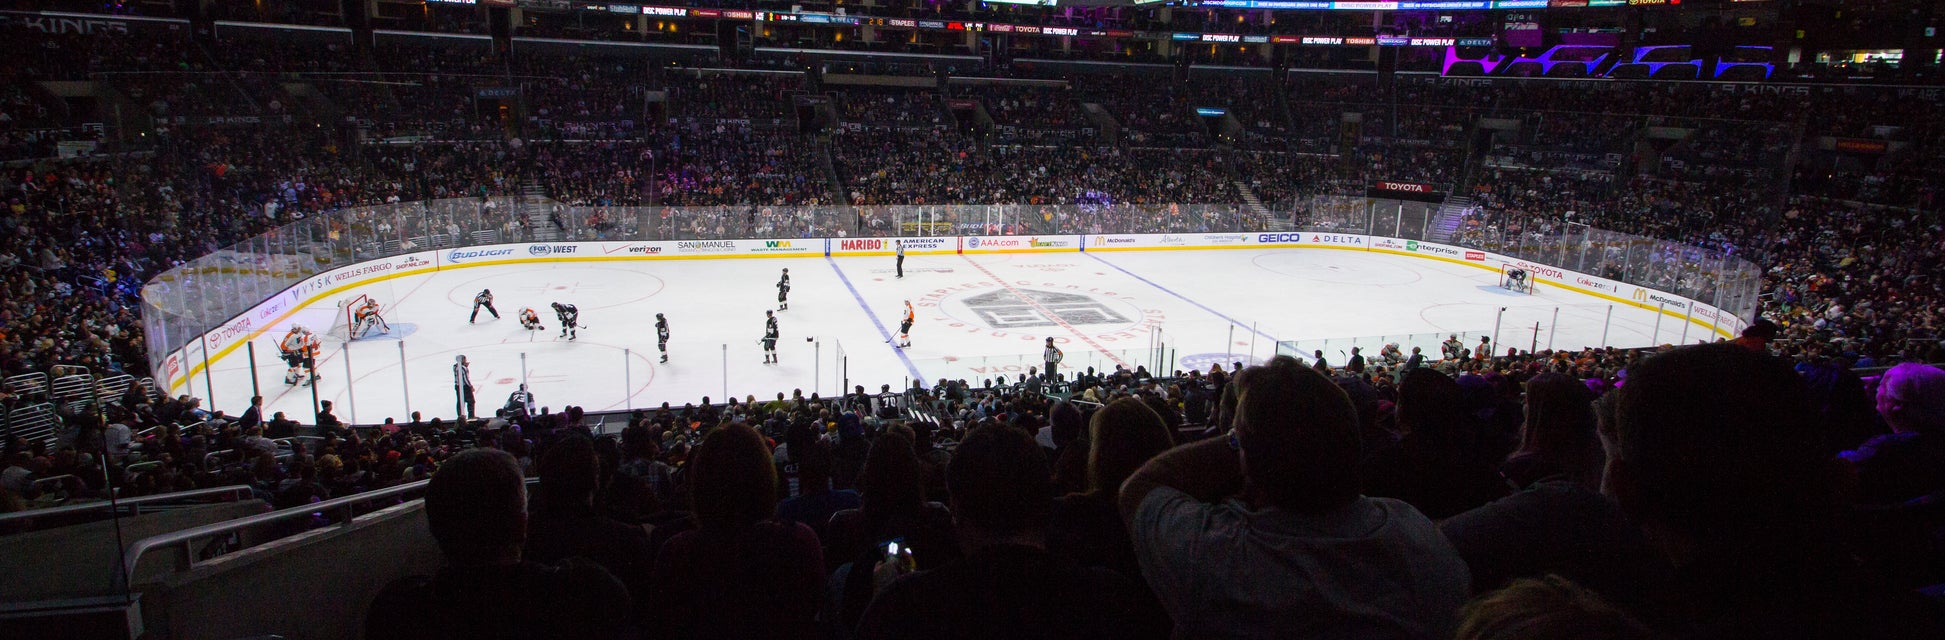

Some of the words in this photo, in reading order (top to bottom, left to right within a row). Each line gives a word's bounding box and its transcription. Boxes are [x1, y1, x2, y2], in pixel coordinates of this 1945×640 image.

[642, 6, 655, 14] DISC
[655, 7, 674, 15] POWER
[674, 8, 687, 16] PLAY
[890, 19, 915, 27] STAPLES
[1014, 25, 1040, 33] TOYOTA
[1385, 182, 1423, 192] TOYOTA
[981, 238, 1019, 247] AAA.com
[1258, 233, 1300, 243] GEICO
[1323, 235, 1362, 244] DELTA
[553, 245, 577, 254] WEST
[628, 245, 662, 254] verizon
[677, 241, 695, 249] SAN
[841, 239, 881, 250] HARIBO
[452, 250, 478, 260] BUD
[479, 249, 514, 257] LIGHT
[334, 268, 362, 281] WELLS
[363, 262, 392, 275] FARGO
[1530, 265, 1563, 279] TOYOTA
[1576, 277, 1595, 287] Coke
[1650, 294, 1686, 309] McDonald's
[1693, 306, 1716, 320] WELLS
[222, 317, 252, 340] TOYOTA
[882, 396, 896, 408] 70
